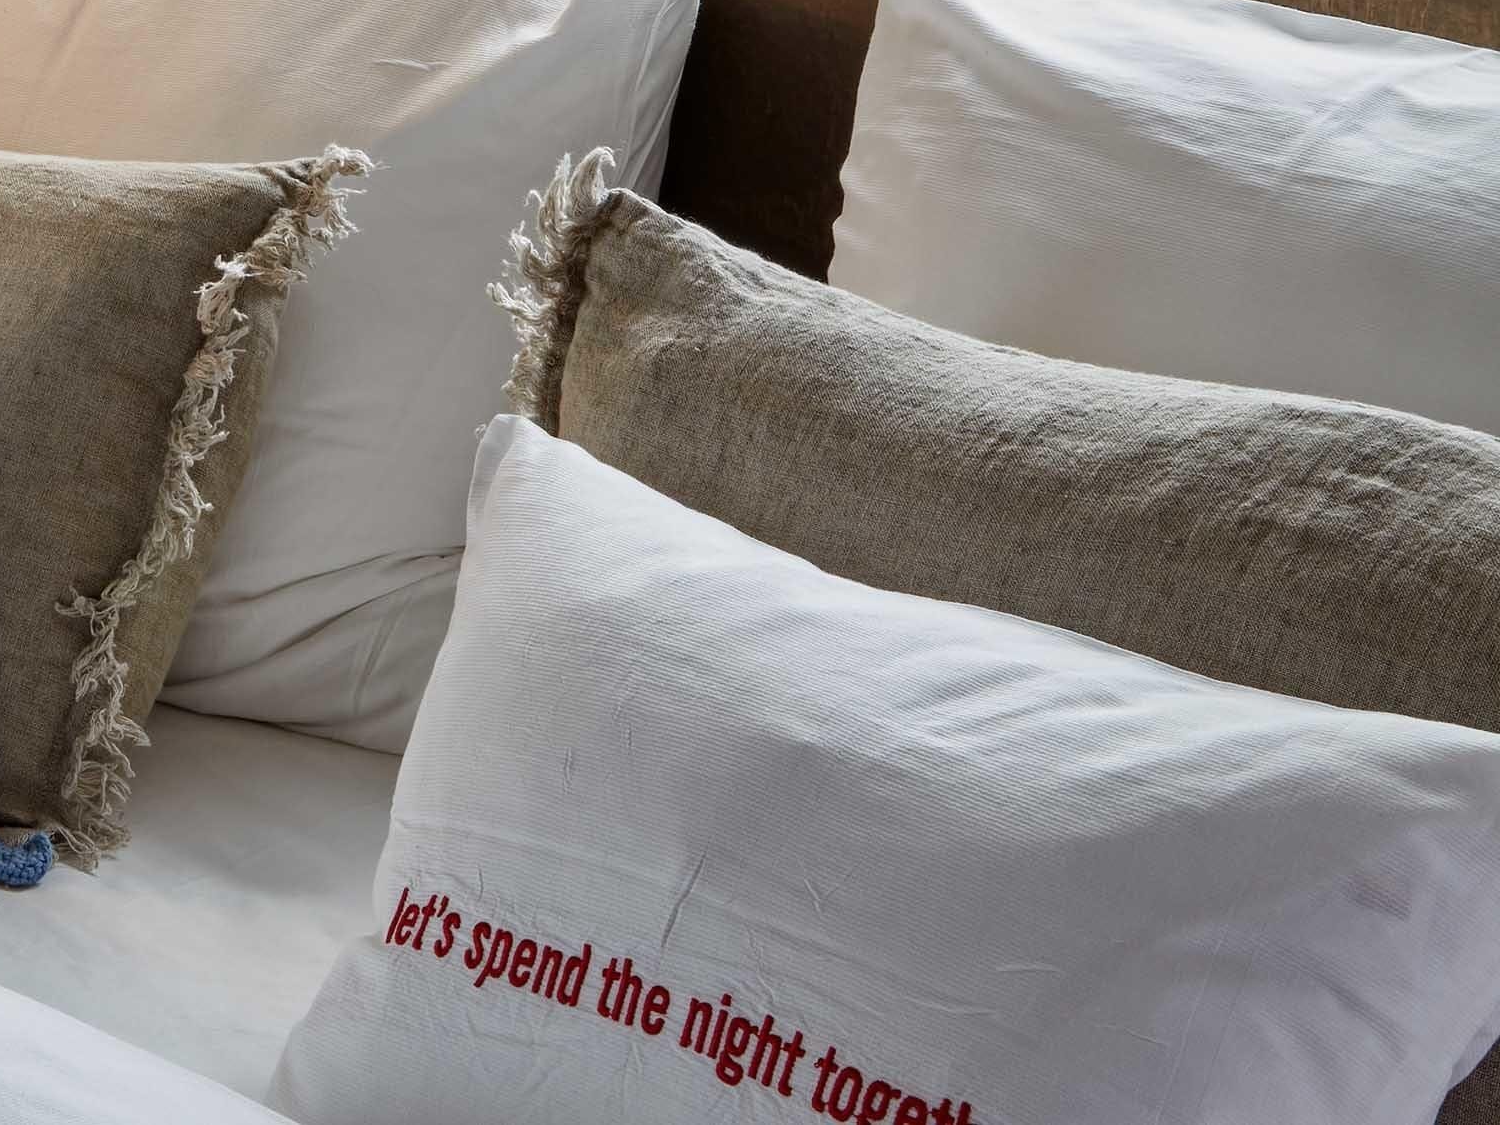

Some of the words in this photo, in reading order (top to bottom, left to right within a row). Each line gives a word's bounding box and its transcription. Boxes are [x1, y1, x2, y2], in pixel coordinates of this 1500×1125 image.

[386, 887, 461, 958] let's
[464, 921, 592, 1007] spend
[597, 957, 671, 1036] the
[679, 993, 806, 1097] night
